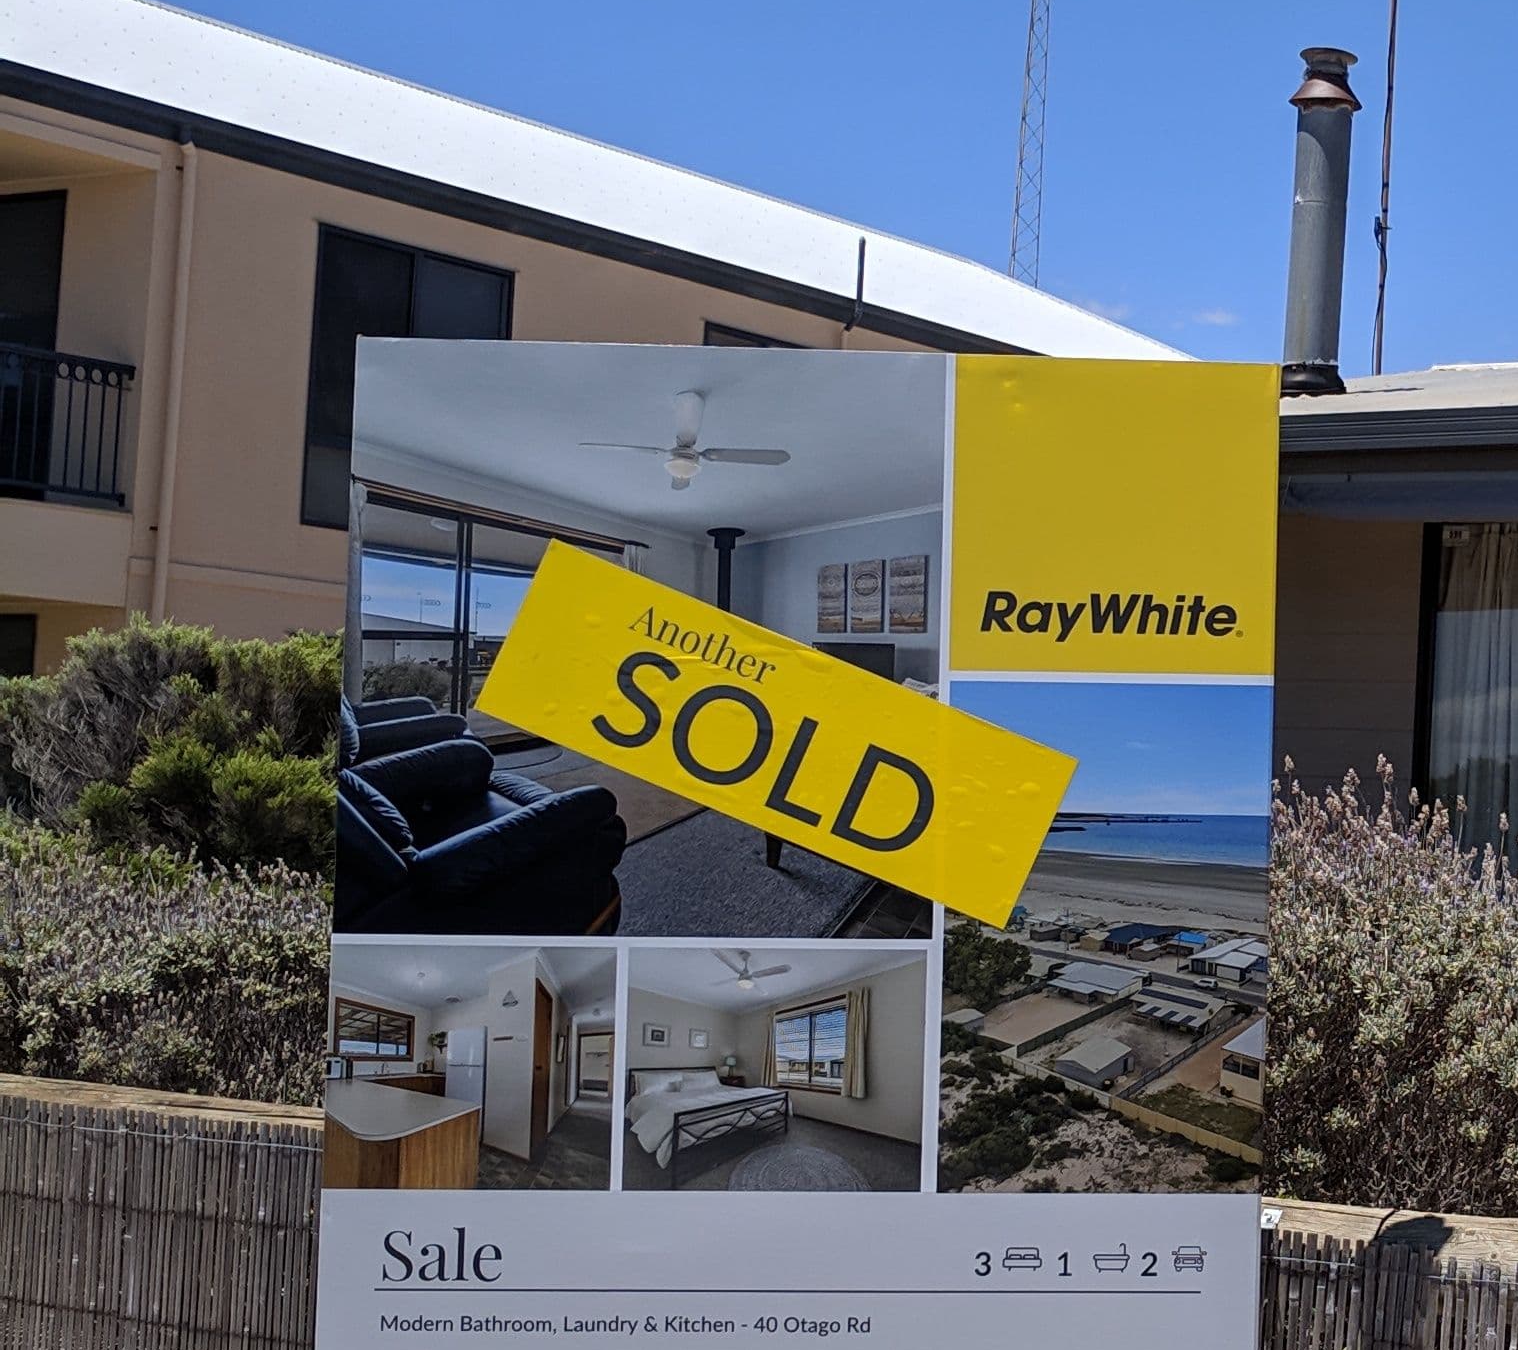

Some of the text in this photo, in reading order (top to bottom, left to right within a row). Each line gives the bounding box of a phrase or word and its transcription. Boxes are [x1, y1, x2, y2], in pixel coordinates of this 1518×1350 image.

[628, 605, 776, 684] Another
[592, 651, 935, 852] SOLD
[381, 1226, 503, 1283] Sale
[974, 1251, 1158, 1277] 3 1 2
[380, 1314, 454, 1332] Modern
[460, 1314, 560, 1339] Bathroom,
[563, 1314, 639, 1336] Laundry
[643, 1315, 659, 1333] &
[664, 1315, 735, 1333] Kitchen
[752, 1316, 779, 1334] 40
[783, 1316, 841, 1338] Otago
[847, 1316, 872, 1334] Rd
